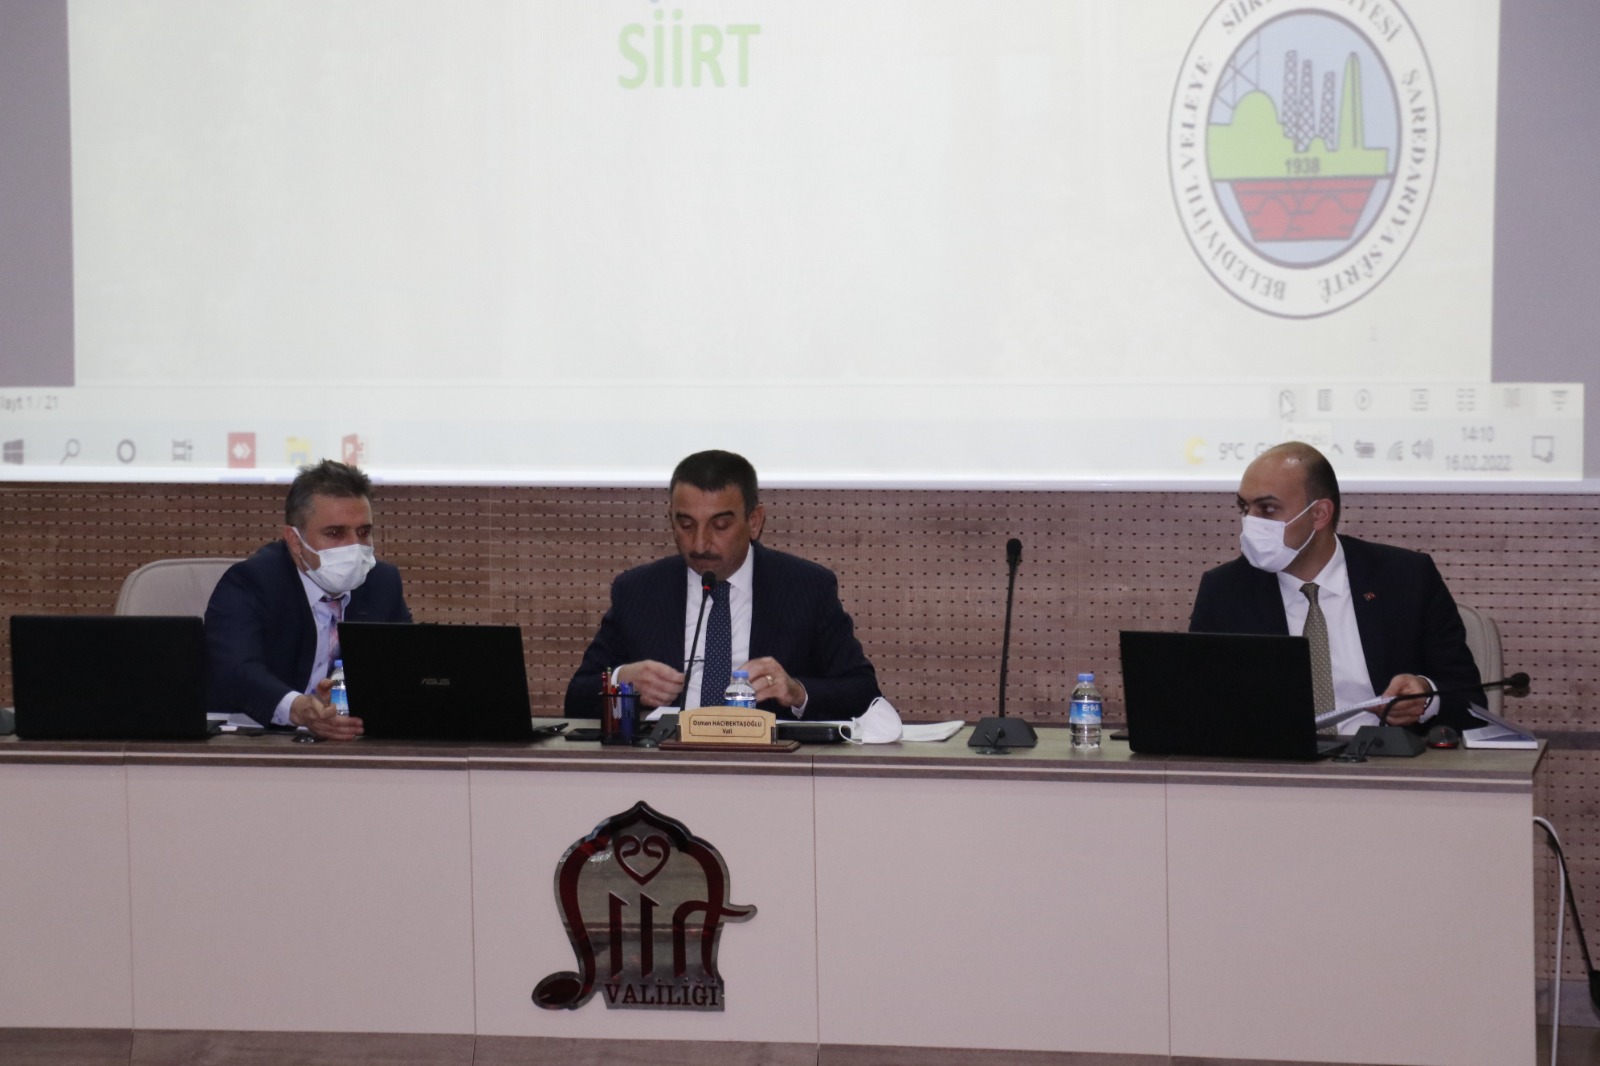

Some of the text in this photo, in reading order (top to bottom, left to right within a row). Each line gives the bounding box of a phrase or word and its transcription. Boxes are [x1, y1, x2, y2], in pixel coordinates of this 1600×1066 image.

[617, 8, 762, 90] SİİRT
[1285, 156, 1321, 175] 1938
[1461, 426, 1495, 443] 14:10
[1445, 455, 1511, 471] 16.02.2022
[420, 678, 450, 686] ASUS
[604, 977, 720, 1007] VALİLİĞİ
